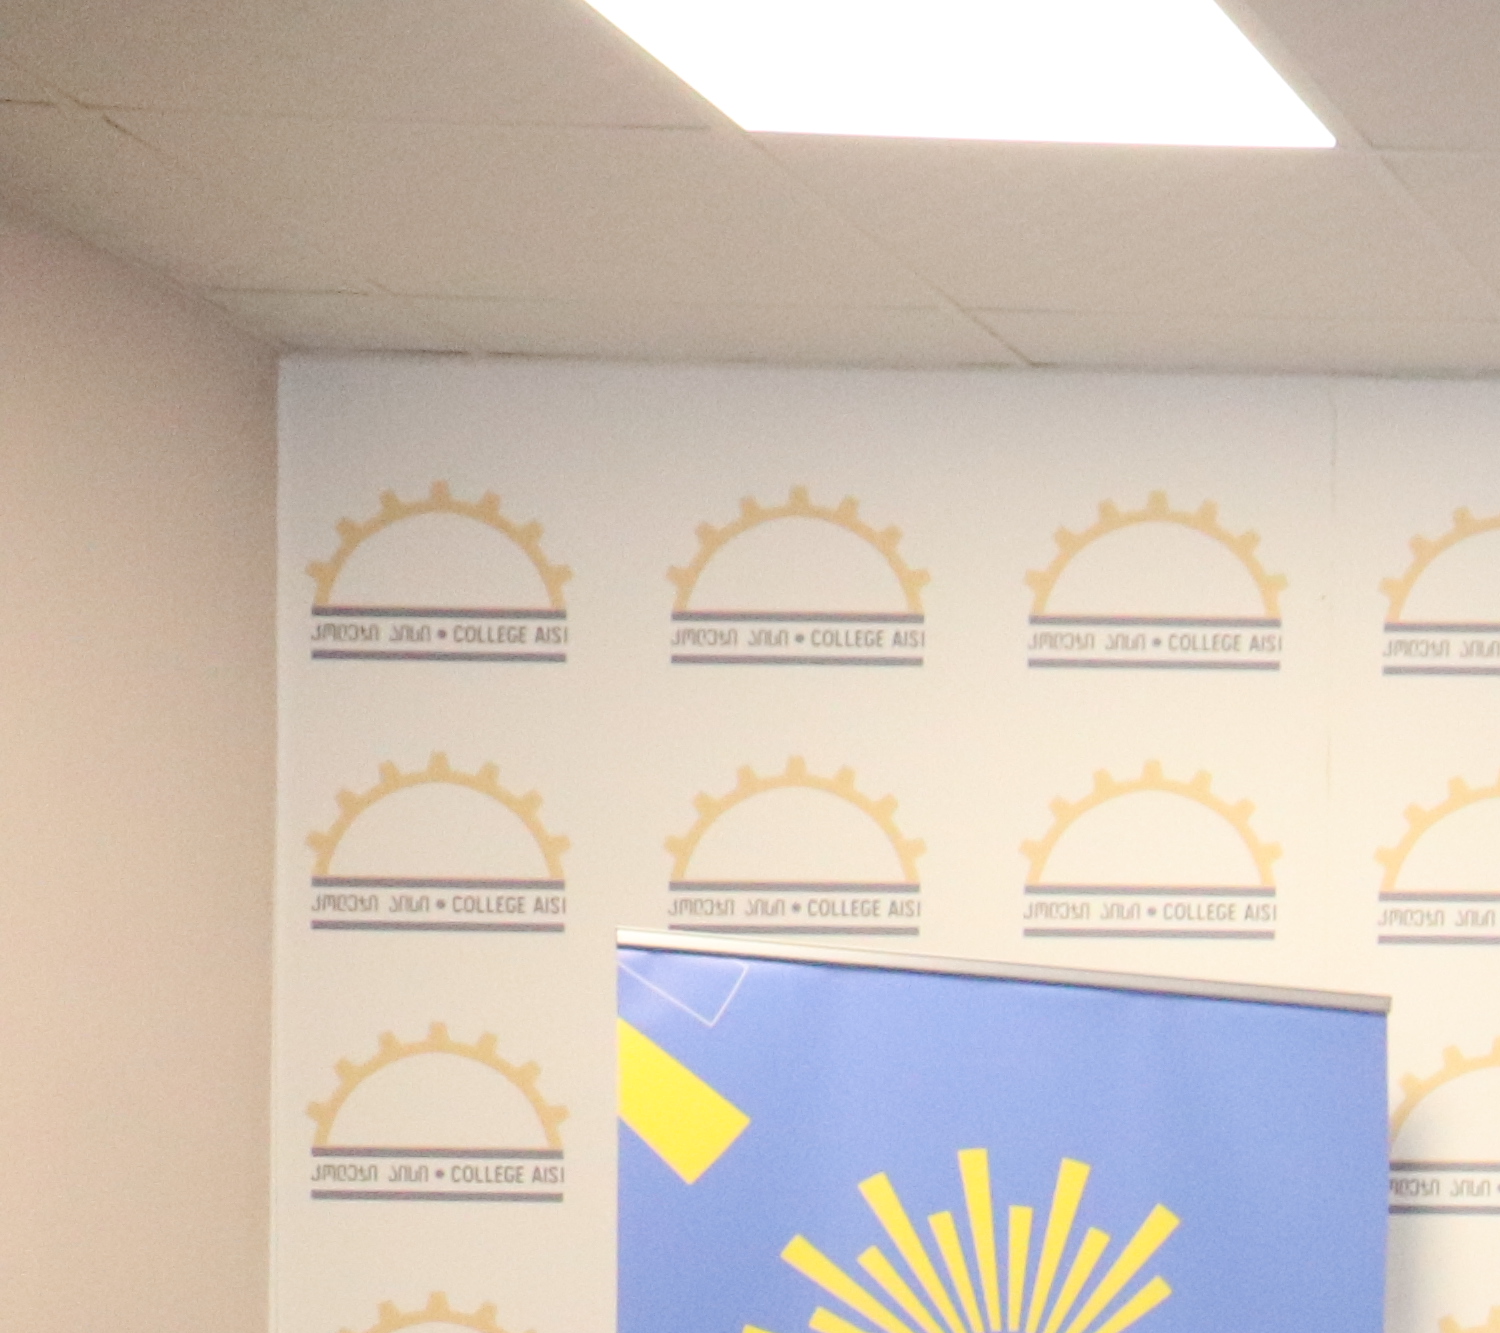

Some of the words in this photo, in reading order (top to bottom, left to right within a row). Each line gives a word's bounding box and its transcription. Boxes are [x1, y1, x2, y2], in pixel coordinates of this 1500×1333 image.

[453, 626, 527, 643] COLLEGE
[534, 626, 568, 644] AISI
[810, 630, 885, 647] COLLEGE
[891, 630, 925, 647] AISI
[1168, 634, 1242, 651] COLLEGE
[1249, 635, 1282, 652] AISI
[452, 896, 526, 913] COLLEGE
[533, 897, 566, 914] AISI
[807, 900, 881, 917] COLLEGE
[888, 900, 921, 917] AISI
[1163, 903, 1237, 920] COLLEGE
[1243, 904, 1277, 921] AISI
[451, 1166, 524, 1183] COLLEGE
[531, 1166, 565, 1183] AISI
